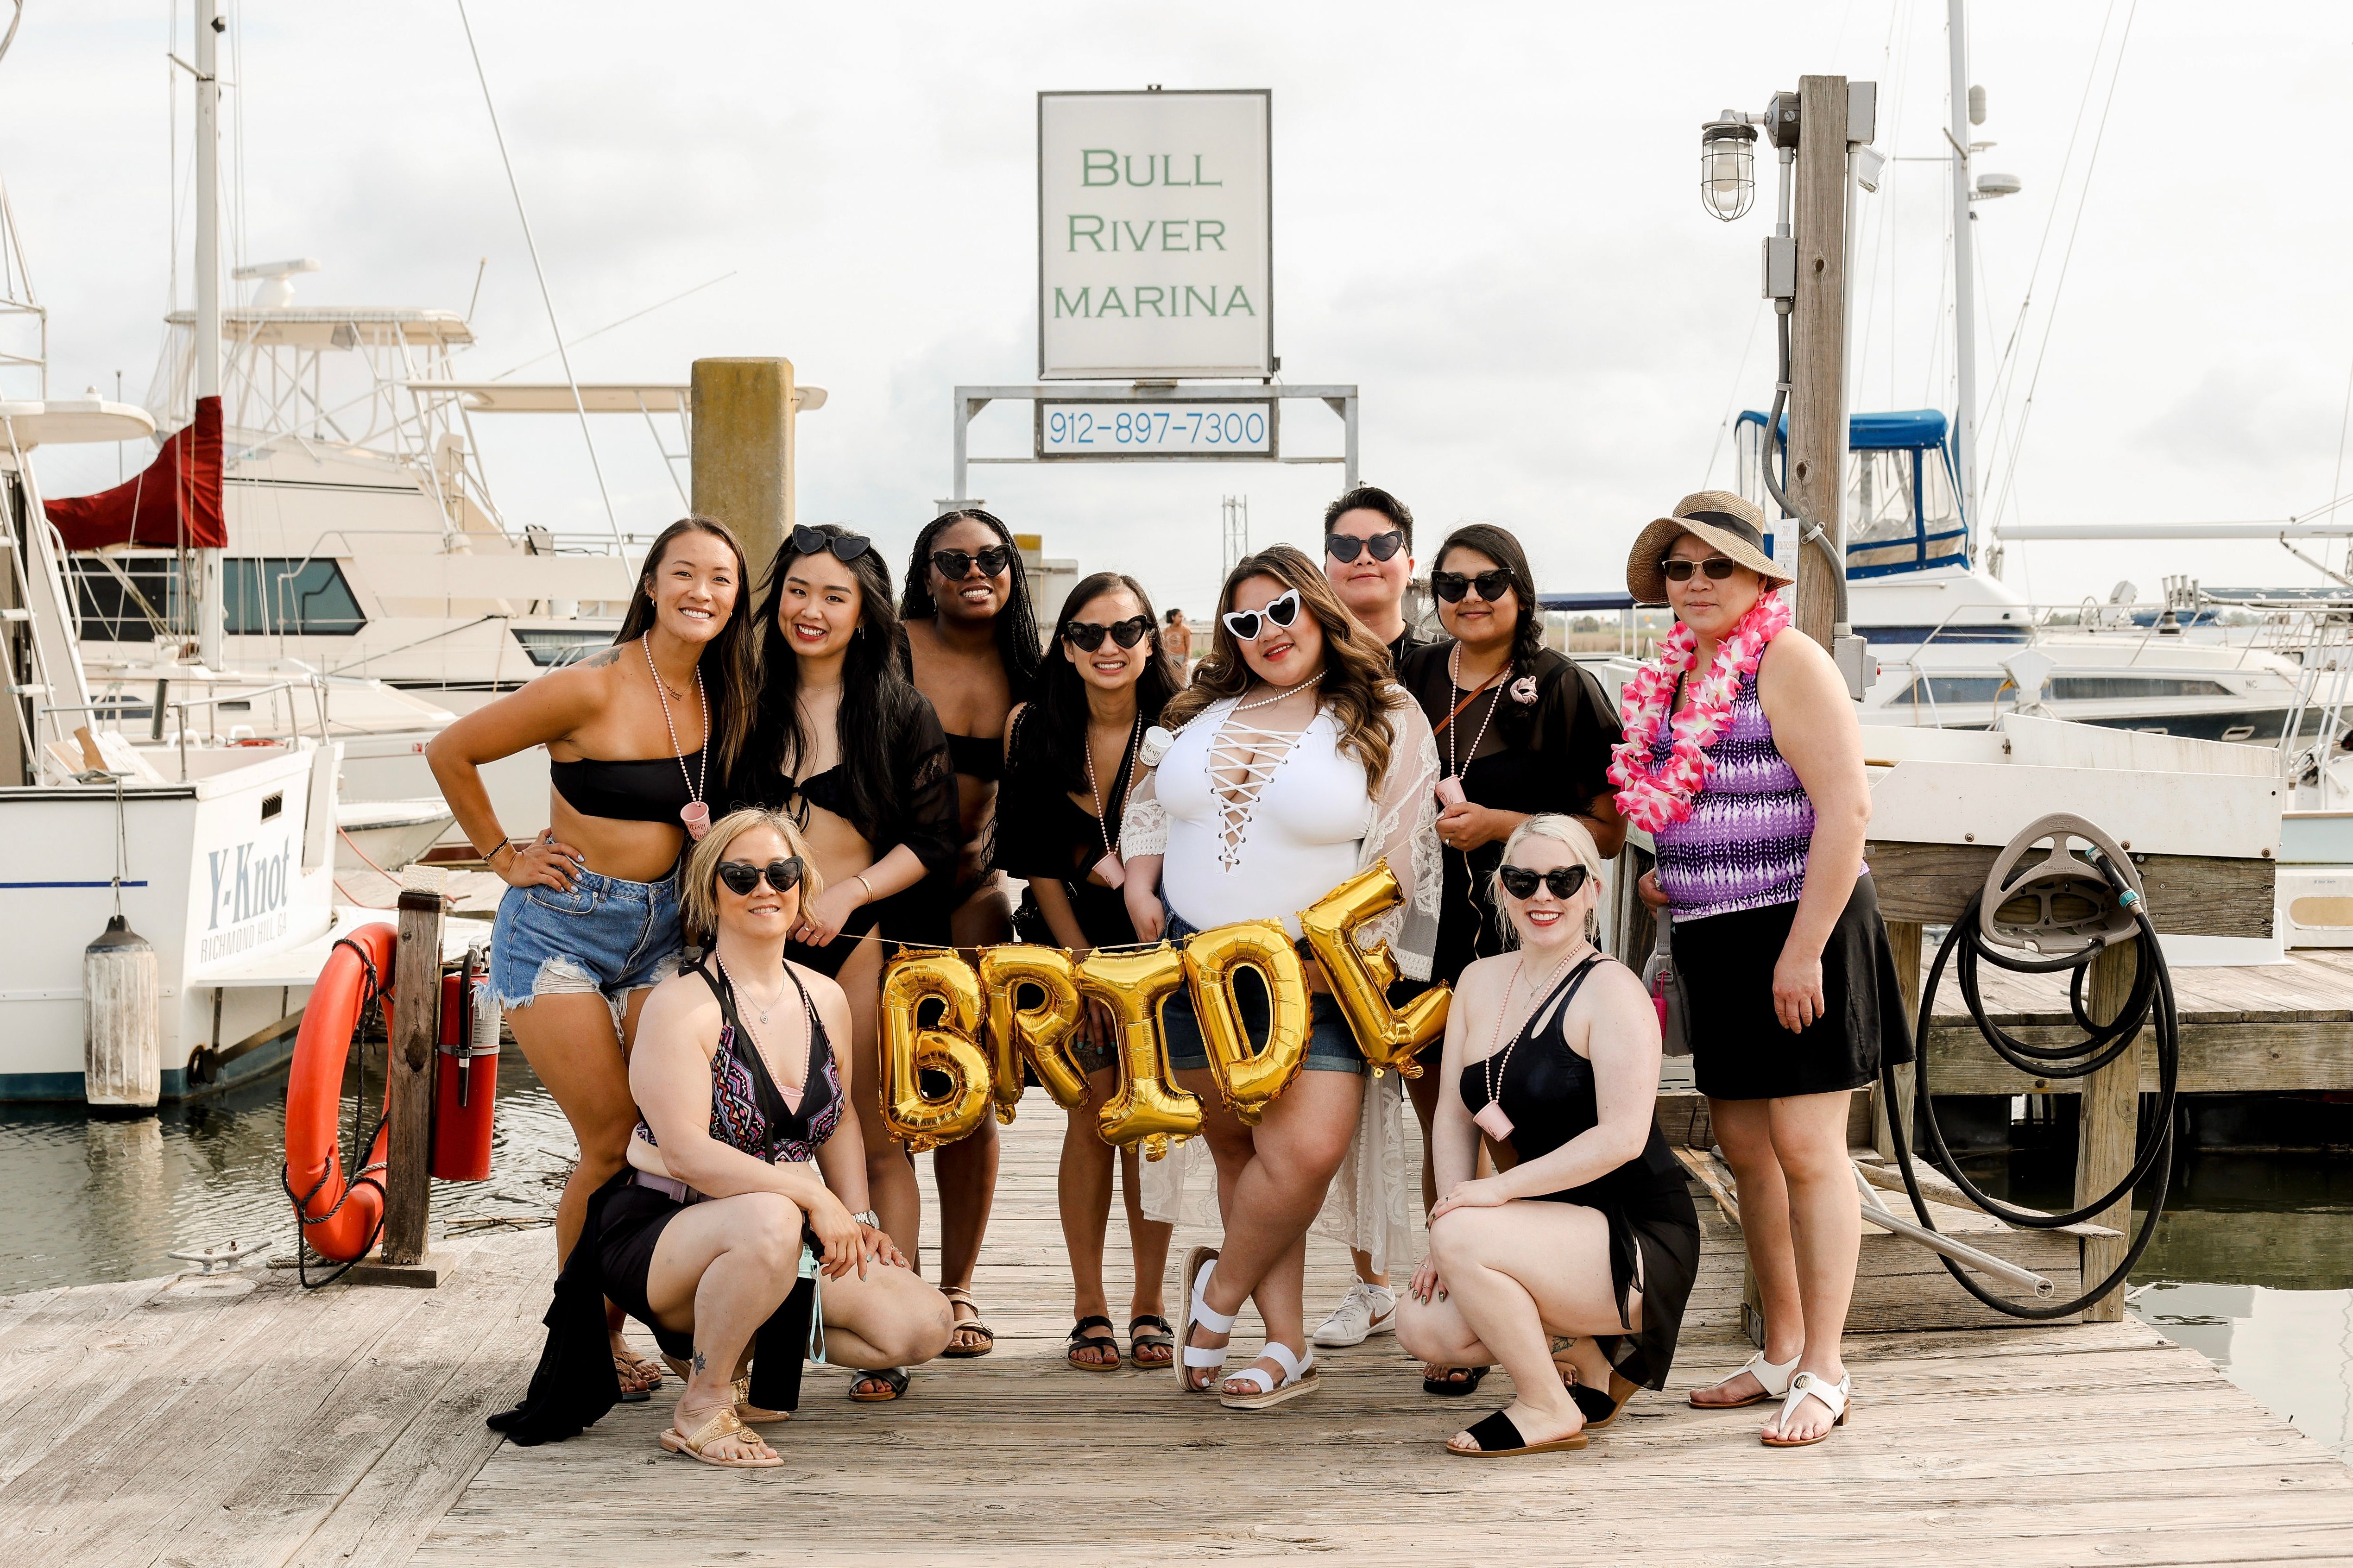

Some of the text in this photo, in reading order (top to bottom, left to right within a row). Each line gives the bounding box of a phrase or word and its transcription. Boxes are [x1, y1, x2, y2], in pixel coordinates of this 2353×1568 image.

[1080, 149, 1223, 187] BULL
[1067, 215, 1227, 252] RIVER
[1053, 285, 1257, 319] MARINA
[1050, 412, 1265, 444] 912-897-7300
[208, 834, 290, 931] Y-Knot
[201, 925, 254, 963] RICHMOND
[278, 912, 287, 937] GA
[877, 856, 1453, 1162] BRIDE
